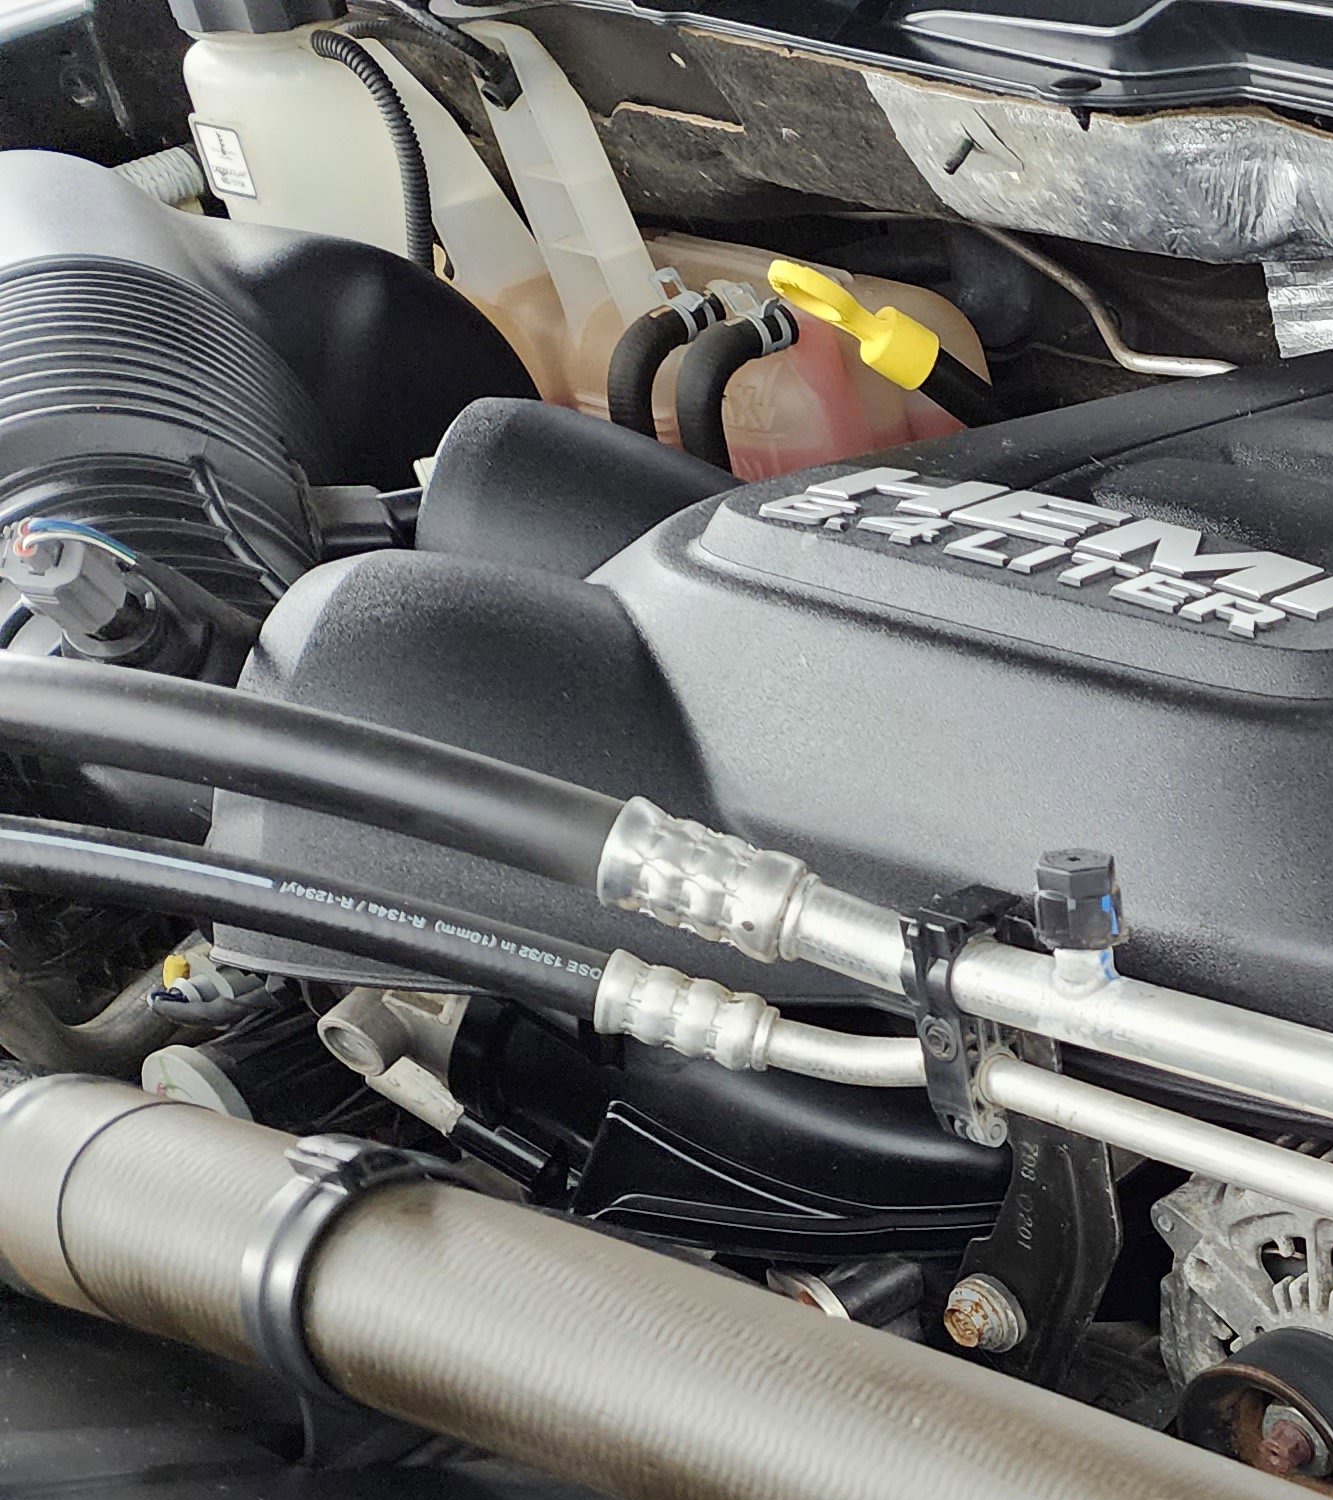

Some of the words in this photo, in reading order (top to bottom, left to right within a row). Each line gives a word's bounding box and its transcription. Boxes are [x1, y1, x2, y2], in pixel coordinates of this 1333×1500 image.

[758, 493, 955, 546] 6.4
[943, 531, 1287, 638] LITER
[279, 880, 355, 911] R-1234yf
[367, 902, 427, 930] R-134a
[434, 919, 497, 948] (10mm)
[516, 944, 563, 968] 13/32
